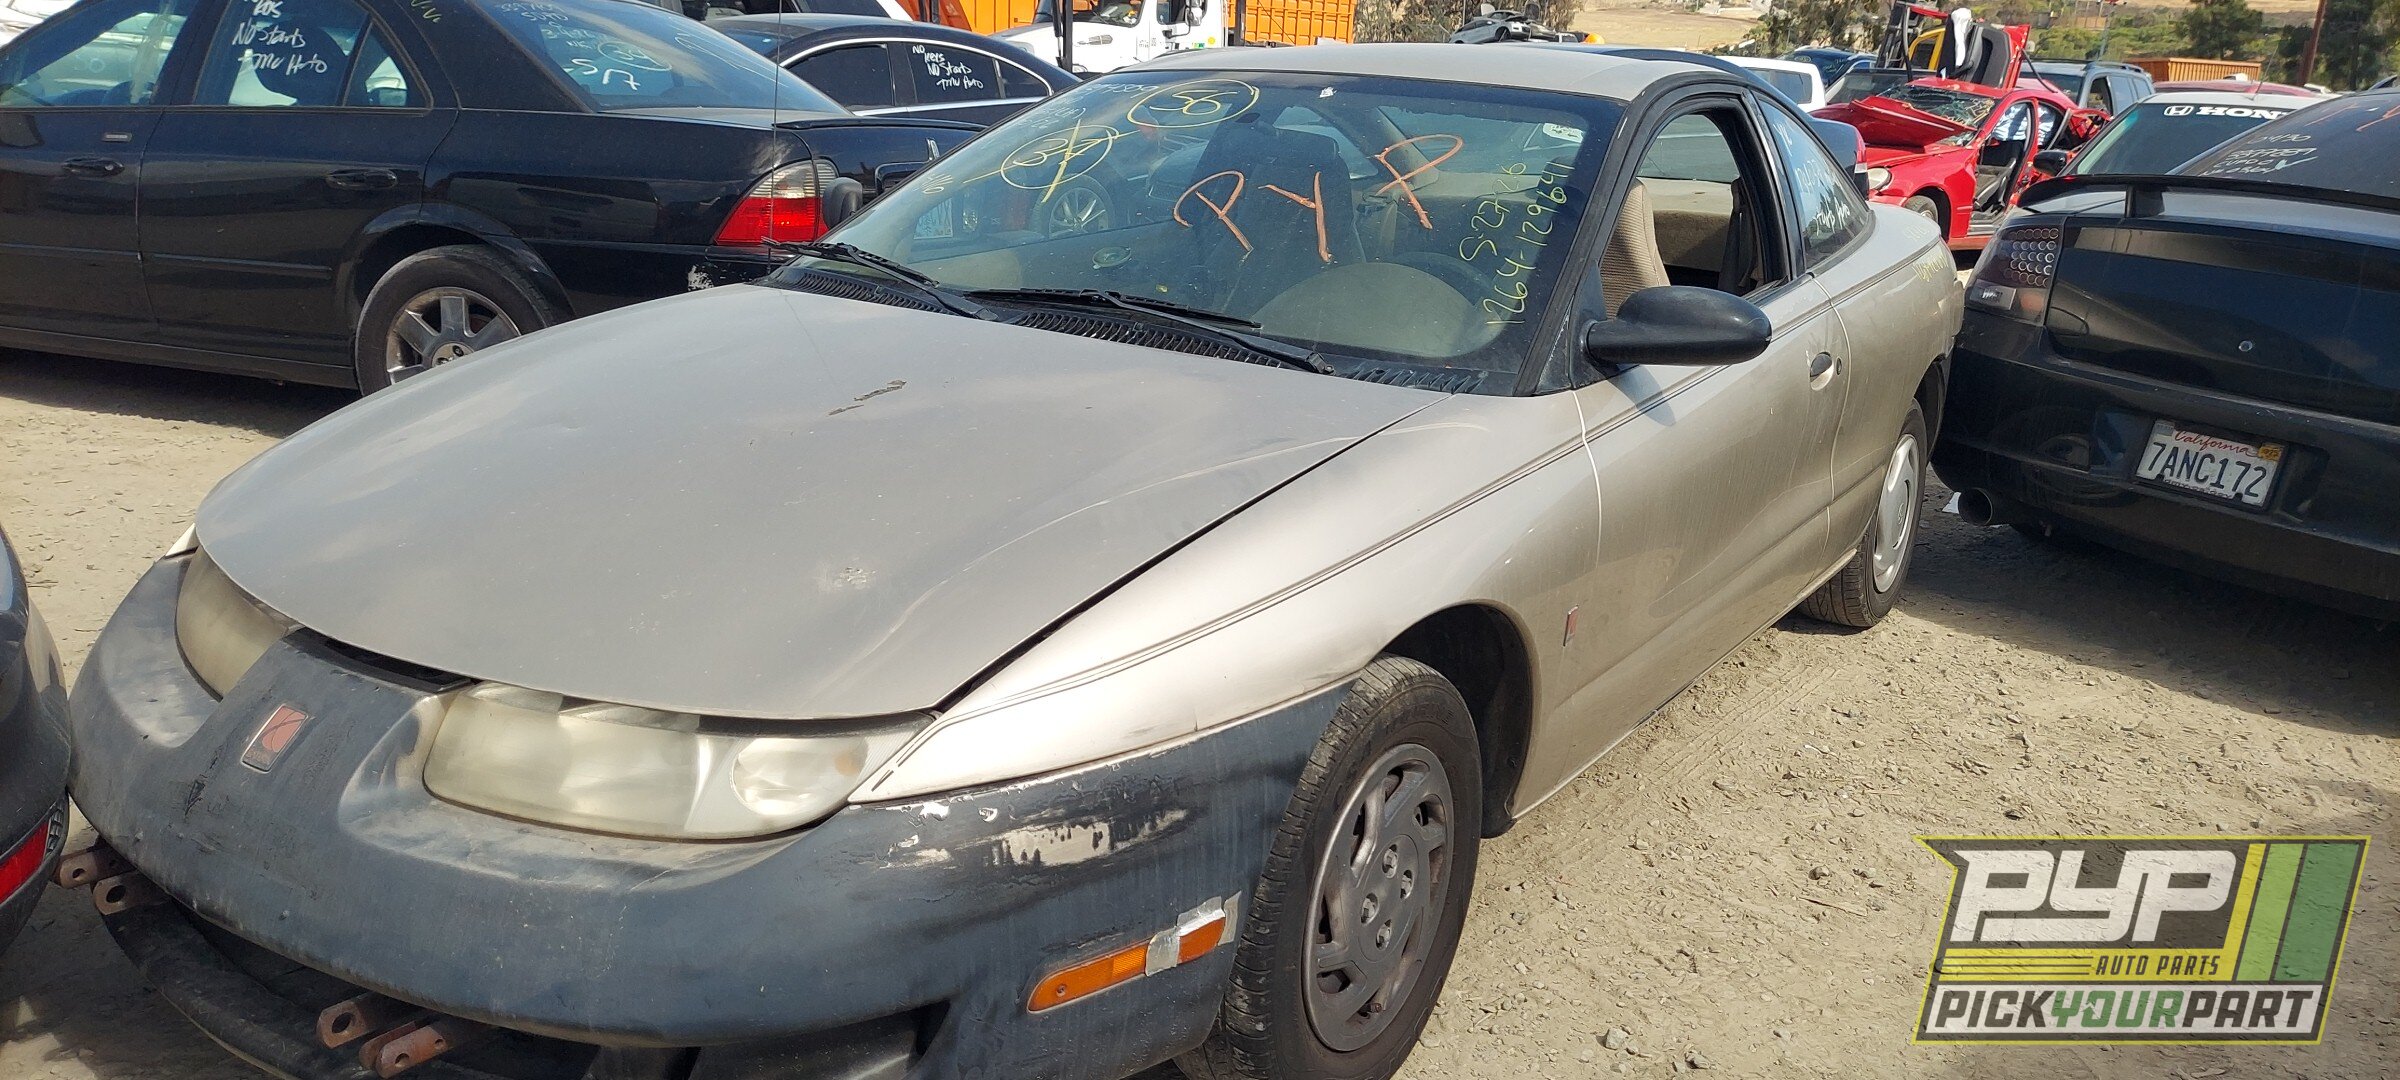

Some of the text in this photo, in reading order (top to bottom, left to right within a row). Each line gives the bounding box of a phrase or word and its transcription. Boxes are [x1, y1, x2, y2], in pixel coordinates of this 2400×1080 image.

[2195, 106, 2288, 120] HON
[2174, 430, 2256, 457] California
[2147, 441, 2267, 498] 7ANC172
